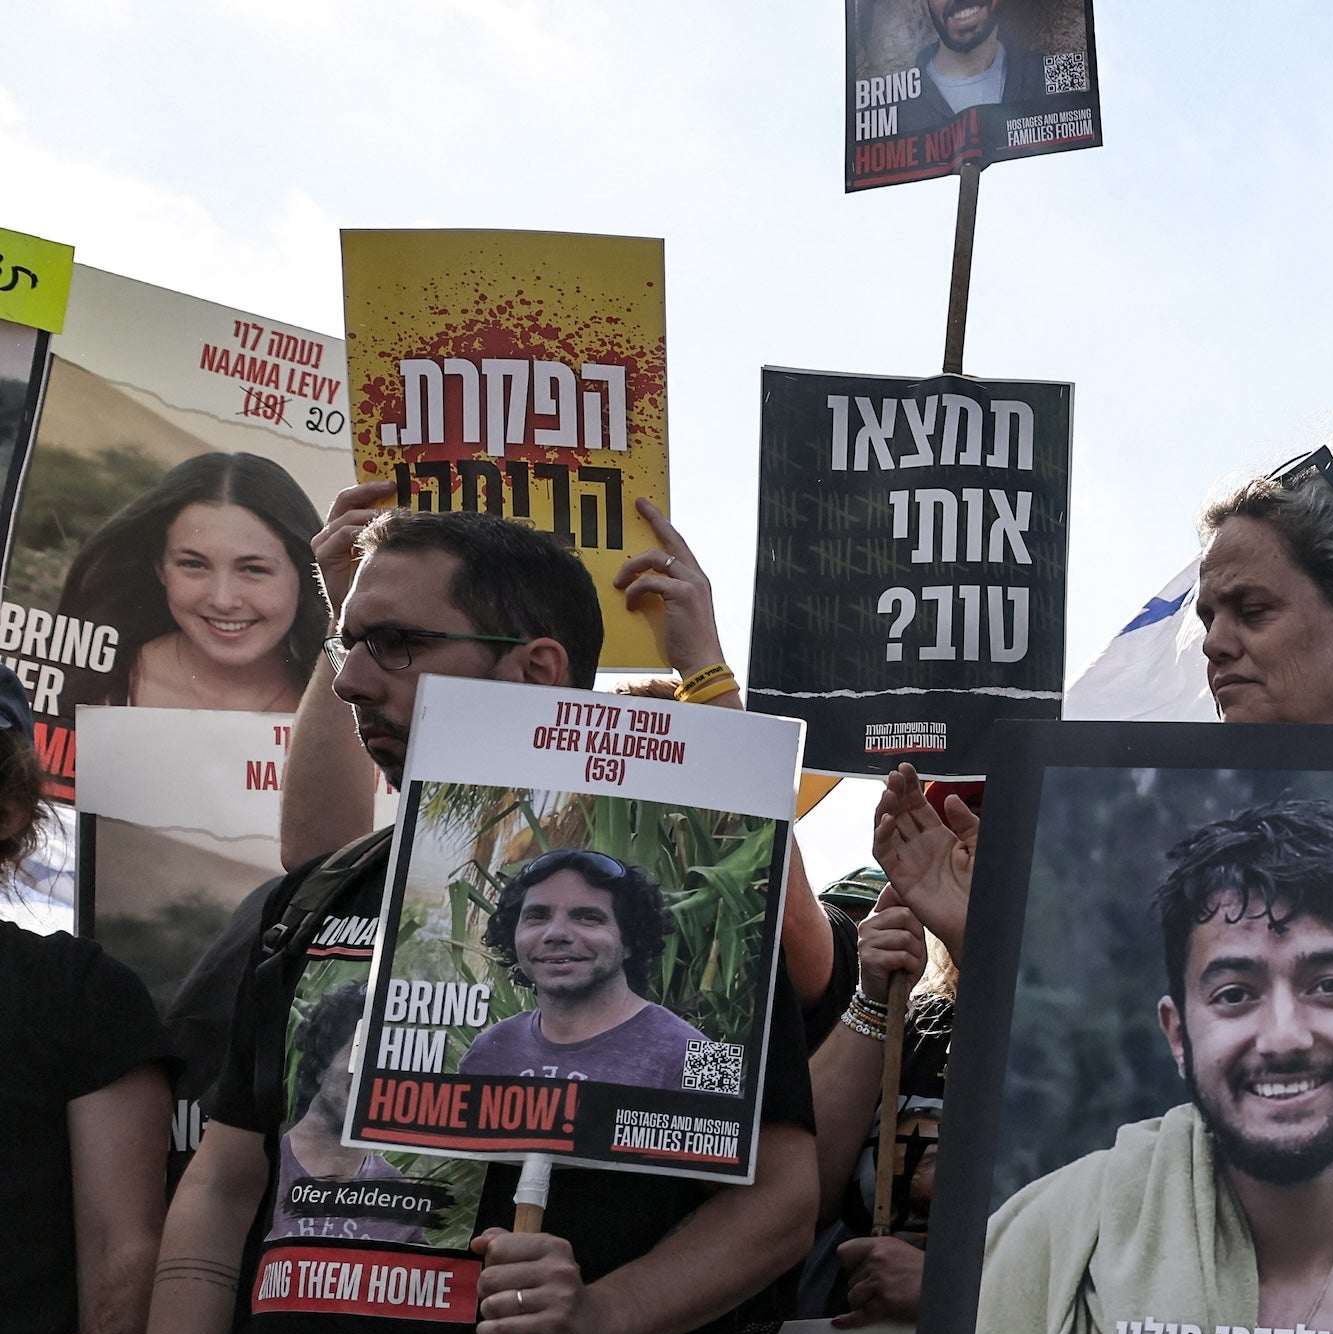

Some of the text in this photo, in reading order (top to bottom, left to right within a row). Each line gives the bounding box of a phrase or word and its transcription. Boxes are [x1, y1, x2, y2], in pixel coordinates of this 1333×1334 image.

[856, 67, 921, 110] BRING
[855, 105, 898, 141] HIM
[856, 107, 980, 175] HOME NOW!
[1006, 108, 1092, 131] HOSTAGES AND MISSING
[1007, 119, 1093, 147] FAMILIES FORUM
[233, 318, 324, 370] נעמה לוי
[199, 343, 342, 405] NAAMA LEVY
[305, 406, 345, 435] 20
[380, 357, 628, 458] הפקרת.
[827, 393, 1035, 472] תמצאו
[889, 488, 1033, 565] אותי
[0, 601, 120, 674] BRING
[877, 585, 1030, 663] טוב?
[555, 701, 672, 736] עופר קלדרון
[865, 723, 893, 736] להחזרת
[533, 726, 686, 765] OFER KALDERON
[864, 734, 947, 750] החטופים והנעדרים
[584, 755, 626, 786] (53)
[384, 978, 491, 1028] BRING
[376, 1025, 447, 1074] HIM
[368, 1077, 579, 1134] HOME NOW!
[616, 1109, 740, 1137] HOSTAGES AND MISSING
[613, 1124, 739, 1158] FAMILIES FORUM
[291, 1185, 432, 1213] Ofer Kalderon
[297, 1261, 364, 1301] THEM
[367, 1266, 454, 1309] HOME
